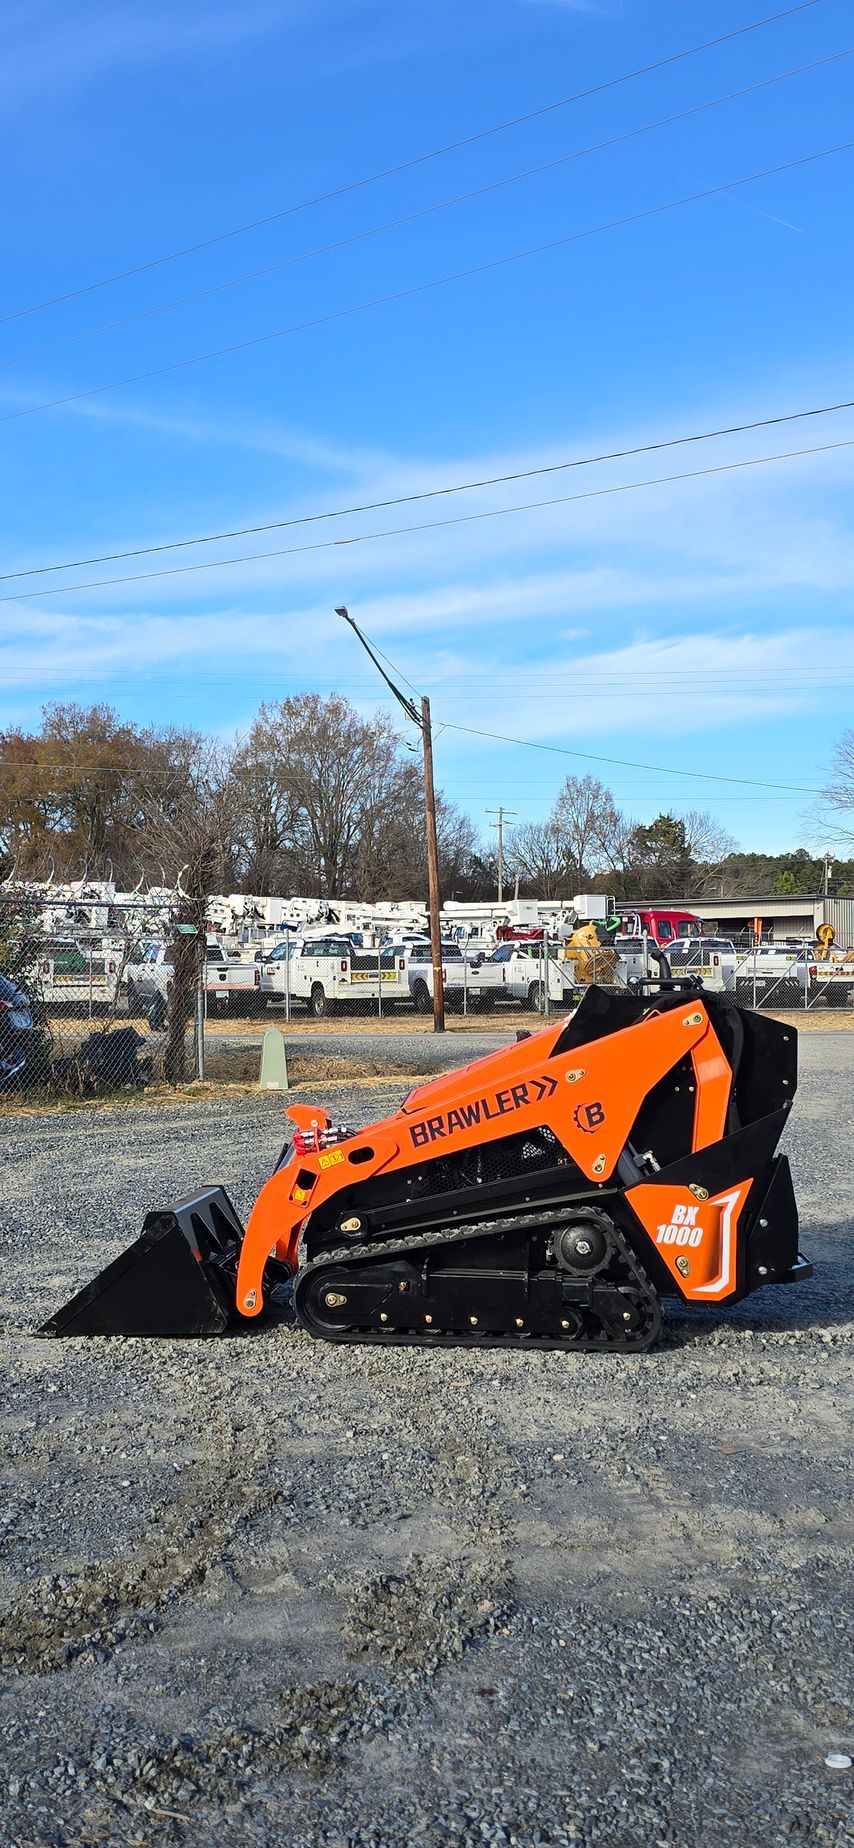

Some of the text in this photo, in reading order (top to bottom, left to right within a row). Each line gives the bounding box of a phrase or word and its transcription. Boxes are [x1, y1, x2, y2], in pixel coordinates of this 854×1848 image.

[409, 1083, 531, 1148] BRAWLER
[585, 1102, 605, 1128] B
[671, 1204, 699, 1226] BX
[656, 1224, 704, 1247] 1000
